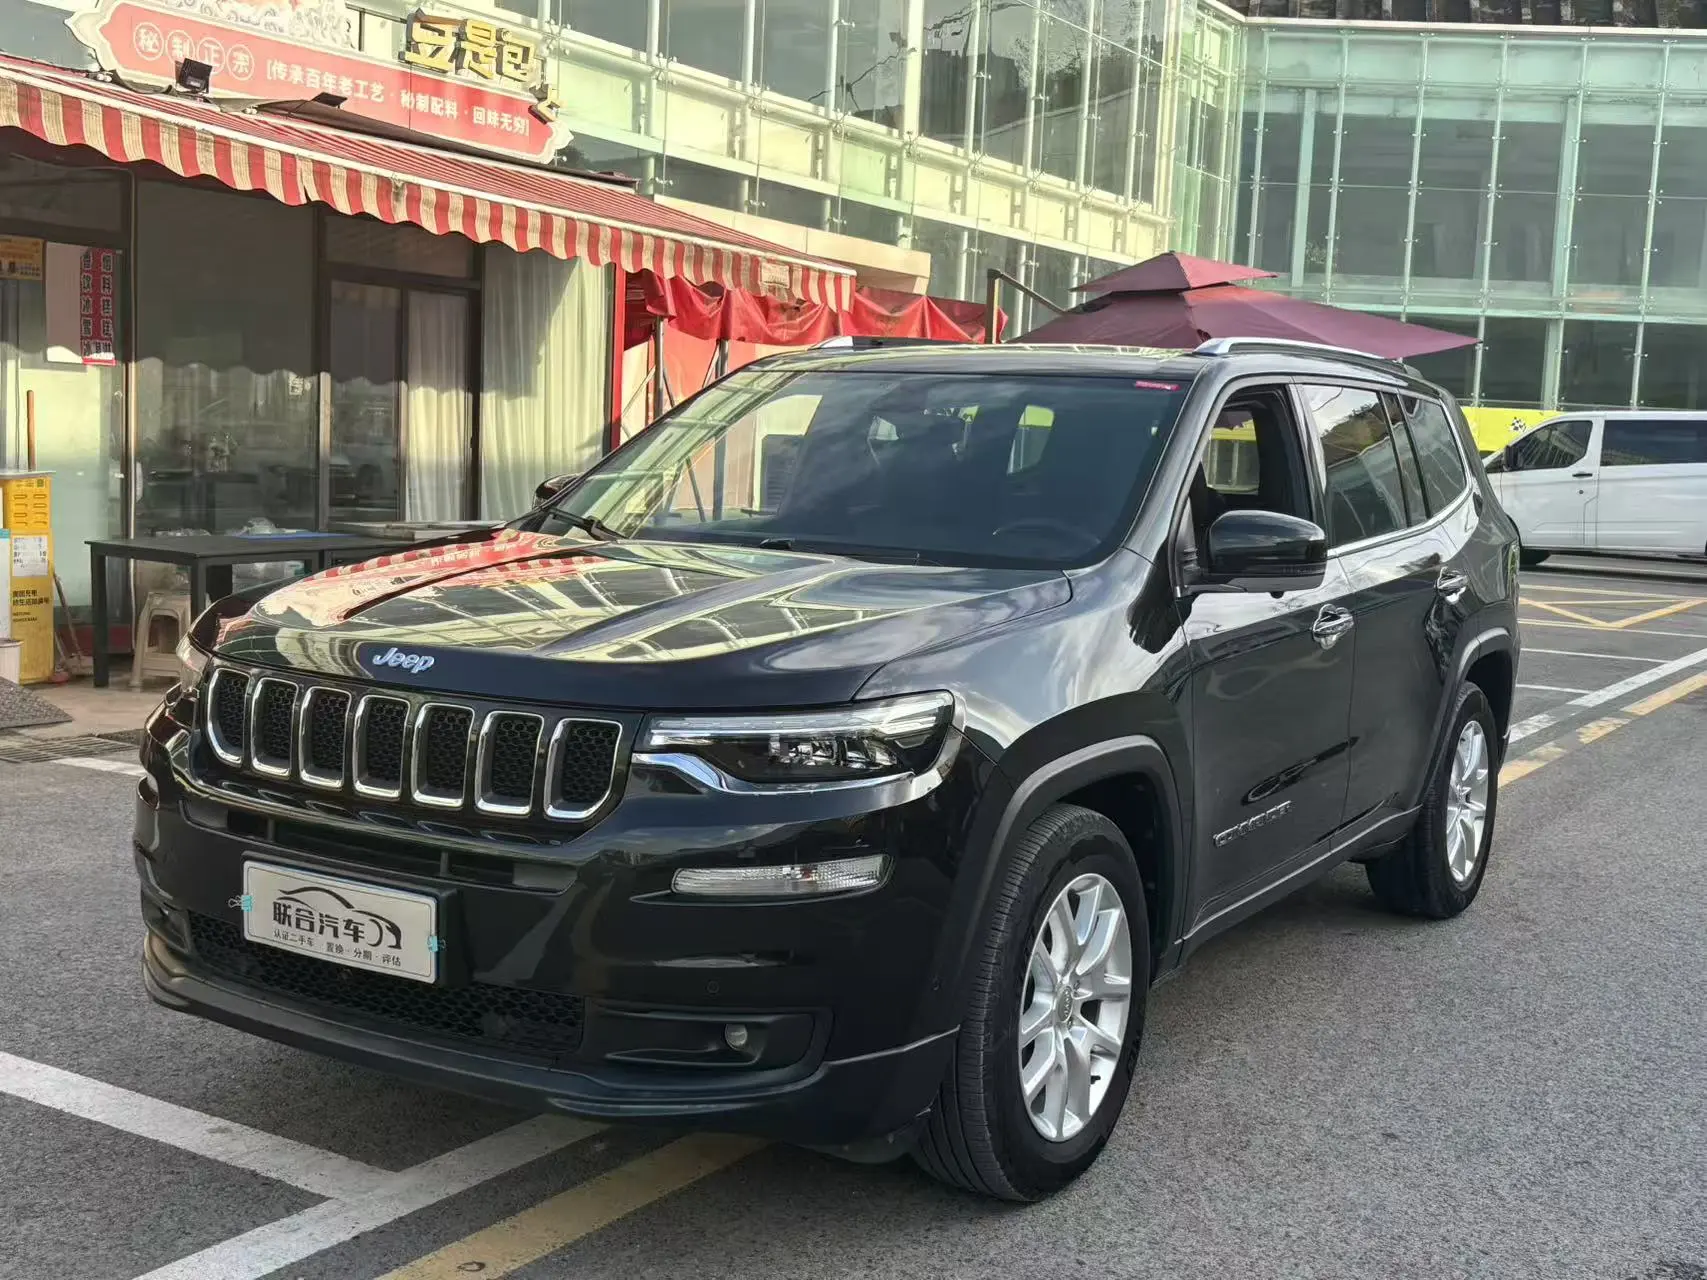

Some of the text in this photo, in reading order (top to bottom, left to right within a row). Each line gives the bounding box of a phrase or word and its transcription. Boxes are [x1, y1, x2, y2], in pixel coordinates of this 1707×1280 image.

[372, 647, 434, 674] Jeep
[273, 901, 365, 943] 联合汽车
